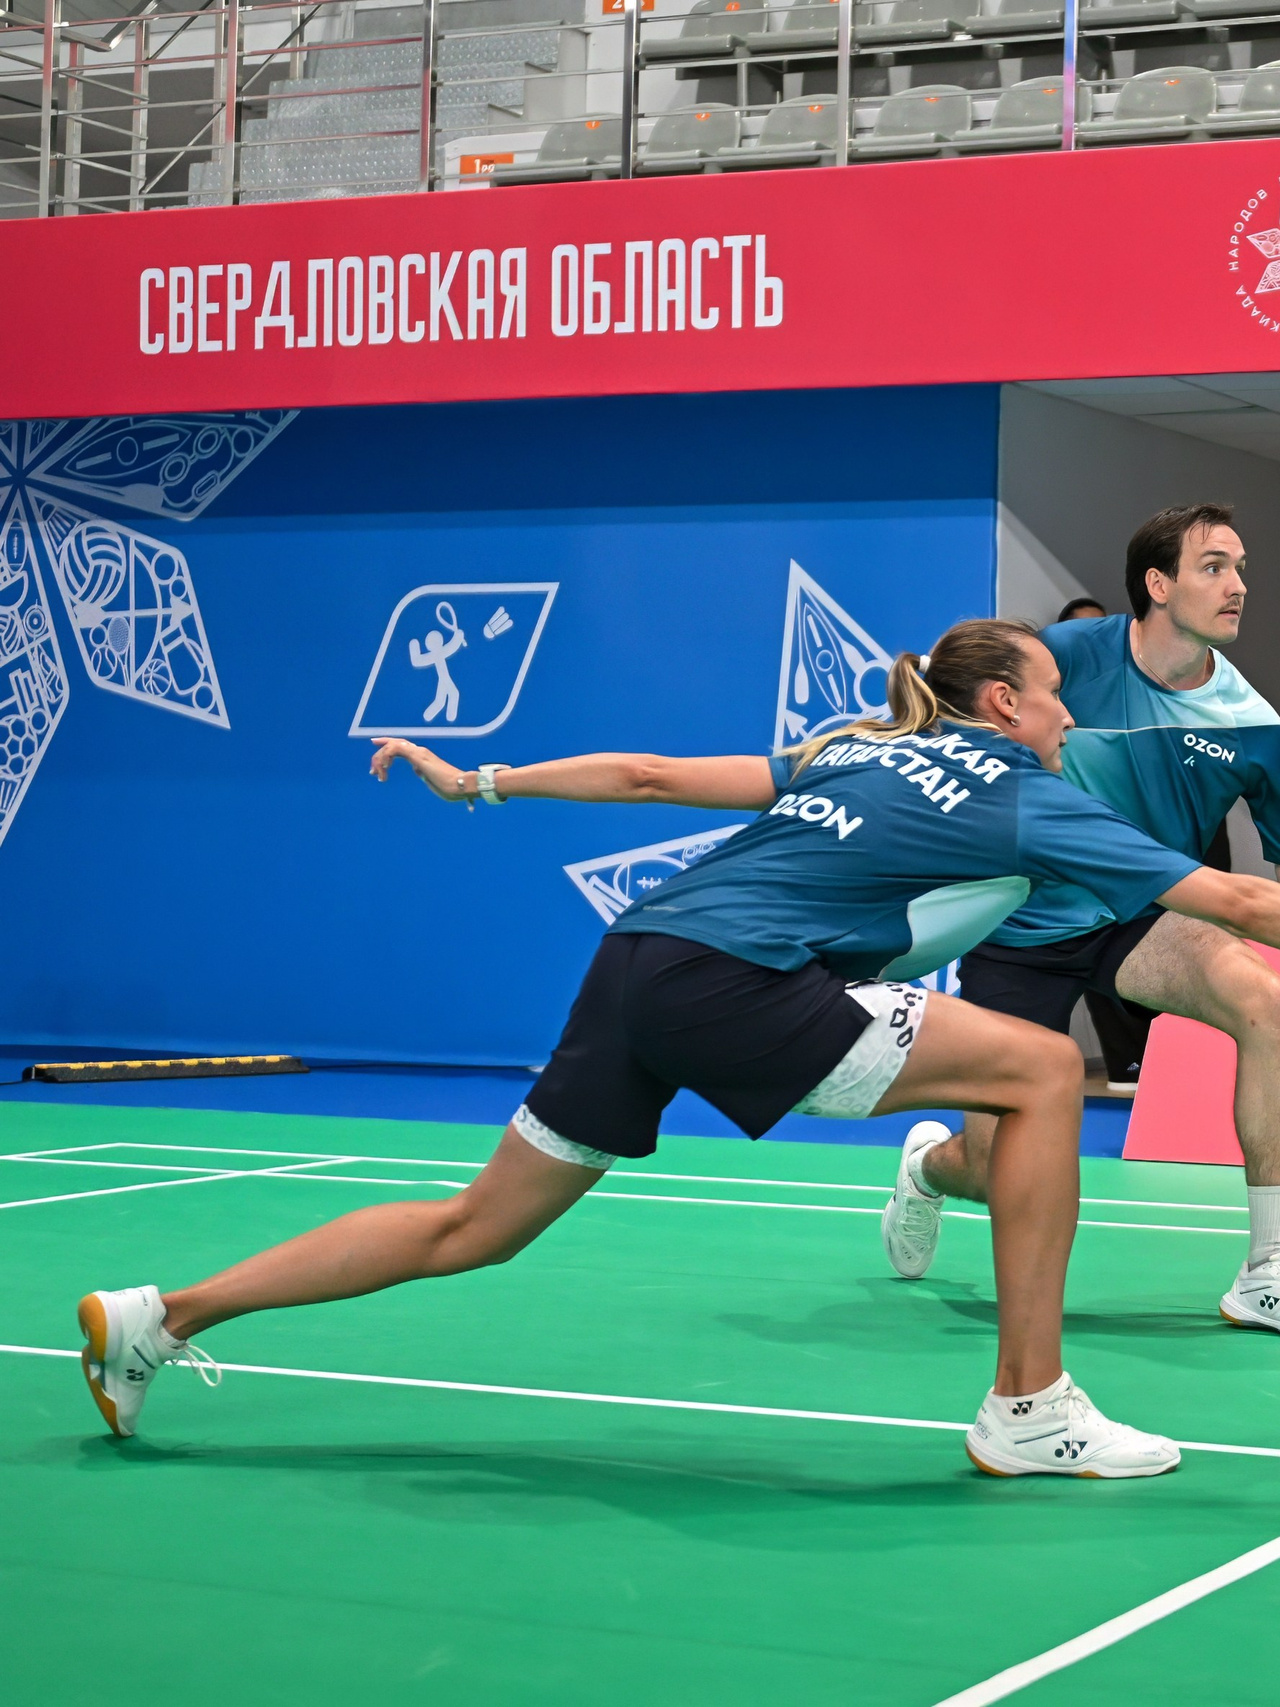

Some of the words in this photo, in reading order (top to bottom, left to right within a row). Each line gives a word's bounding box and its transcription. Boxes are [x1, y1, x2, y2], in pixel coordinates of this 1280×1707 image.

[1228, 188, 1268, 272] НАРОДОВ
[139, 246, 528, 355] СВЕРДЛОВСКАЯ
[551, 234, 784, 337] ОБЛАСТЬ
[810, 744, 971, 814] ТАТАРСТАН
[1183, 733, 1236, 764] OZON
[769, 794, 864, 840] OZON
